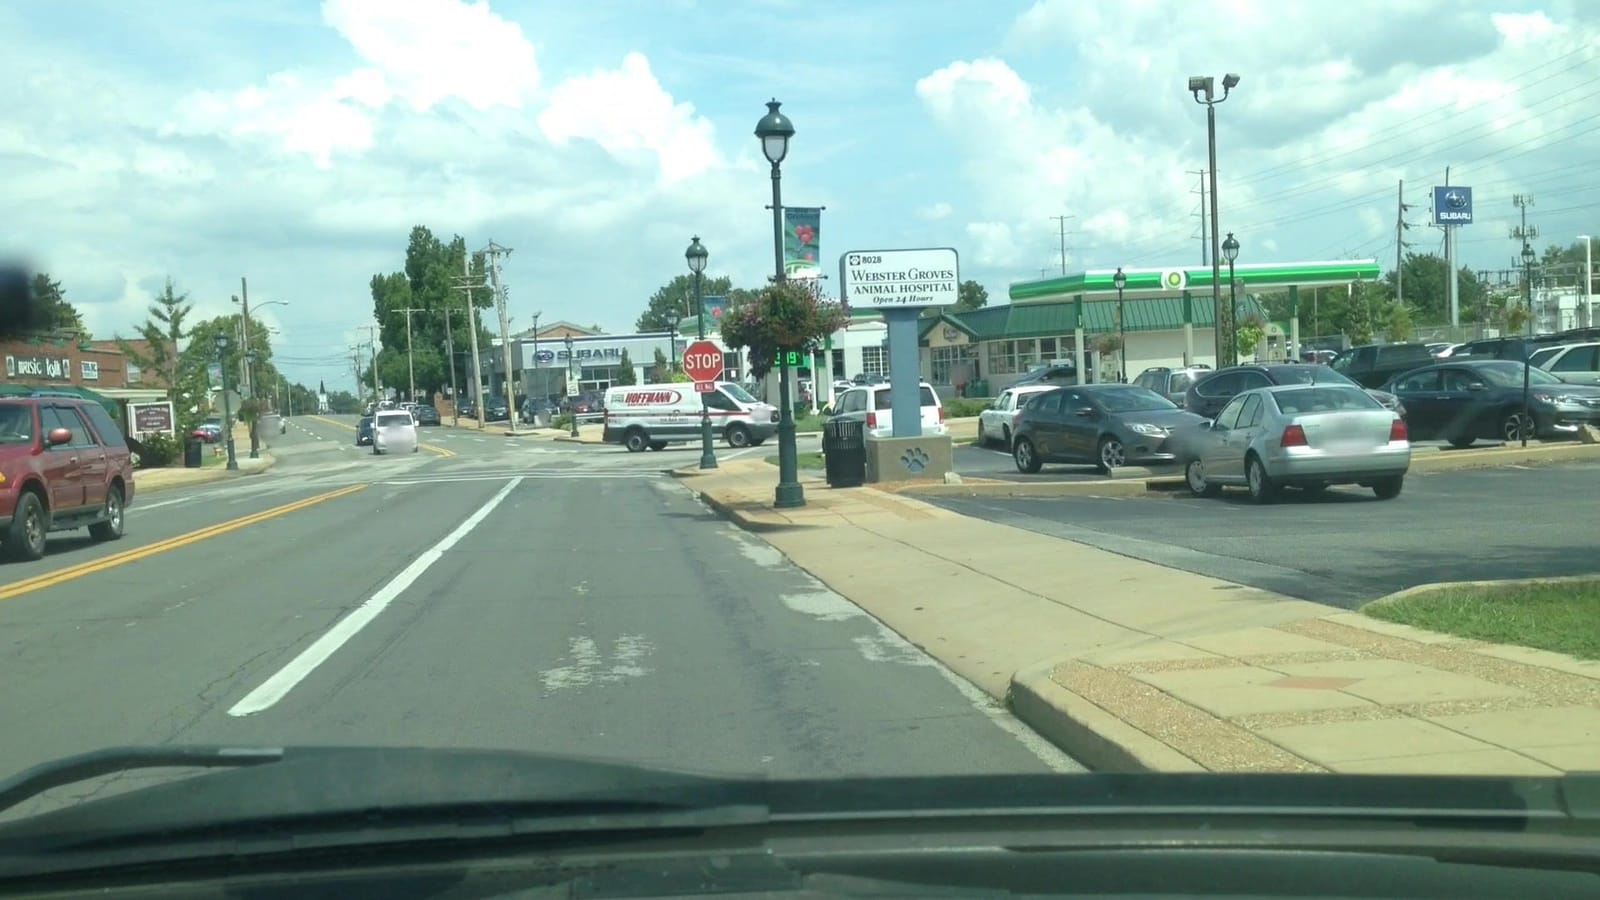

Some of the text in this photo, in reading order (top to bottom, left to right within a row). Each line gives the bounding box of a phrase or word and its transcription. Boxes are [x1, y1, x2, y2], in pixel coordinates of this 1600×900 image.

[1440, 212, 1471, 220] SUBARU
[862, 256, 882, 264] 8028
[851, 268, 954, 281] WEBSTER GROVES
[854, 283, 954, 294] ANIMAL HOSPITAL
[873, 296, 893, 304] Open
[896, 296, 906, 304] 24
[686, 353, 721, 369] STOP
[625, 392, 672, 403] HOFFMANN
